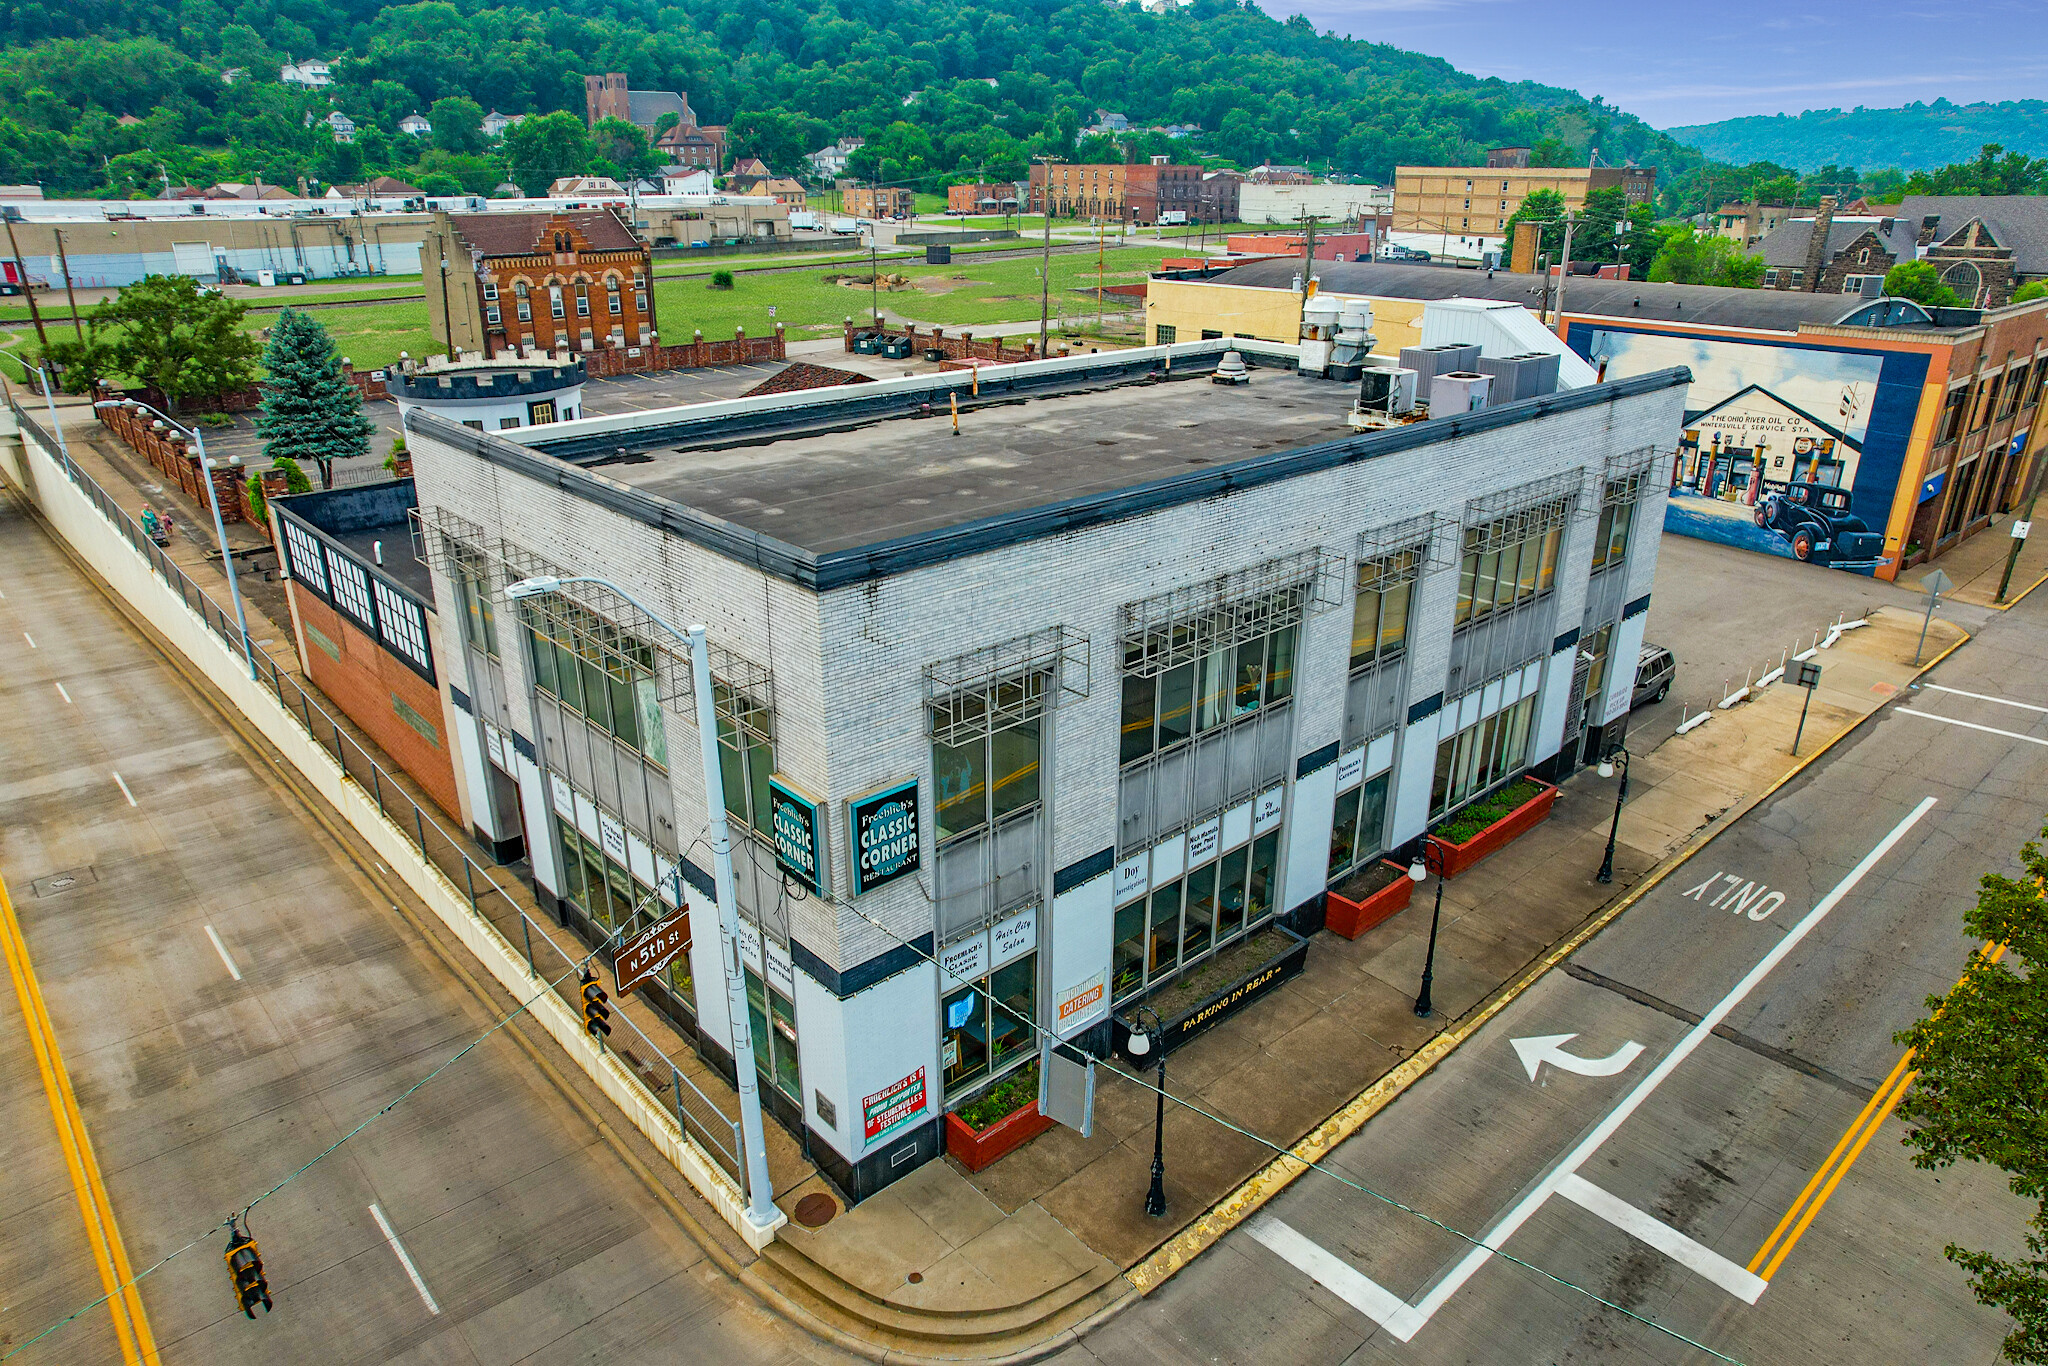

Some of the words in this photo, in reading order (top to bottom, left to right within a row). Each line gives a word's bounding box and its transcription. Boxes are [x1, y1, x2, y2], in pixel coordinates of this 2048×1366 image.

[1700, 422, 1747, 430] WINTERSVILLE
[1750, 424, 1786, 432] SERVICE
[1791, 426, 1813, 434] STA.
[1711, 415, 1727, 423] THE
[1727, 415, 1744, 423] OHIO
[1745, 416, 1766, 424] RIVER
[1768, 417, 1782, 425] OIL
[1787, 417, 1801, 425] CO
[773, 812, 812, 851] CLASSIC
[861, 812, 916, 849] CLASSIC
[774, 832, 814, 872] CORNER
[861, 832, 918, 870] CORNER
[863, 853, 918, 883] RESTAURANT
[1124, 864, 1140, 880] Doy
[1681, 871, 1786, 922] ONLY
[995, 929, 1013, 942] Hair
[1014, 918, 1032, 935] City
[630, 958, 638, 972] N
[639, 938, 665, 965] 5th
[668, 929, 680, 945] St
[1001, 937, 1025, 954] Salon
[948, 954, 979, 971] CLASSIC
[949, 962, 978, 979] CORNER
[1063, 988, 1100, 1016] CATERING
[1064, 976, 1100, 1002] WEDDINGS
[1182, 996, 1230, 1032] PARKING
[1231, 988, 1244, 1003] IN
[1245, 969, 1274, 994] REAR
[1058, 999, 1105, 1030] GRADUATIONS
[909, 1072, 917, 1084] IS
[919, 1067, 924, 1078] A
[868, 1119, 875, 1129] OF
[880, 1106, 912, 1130] FESTIVALS
